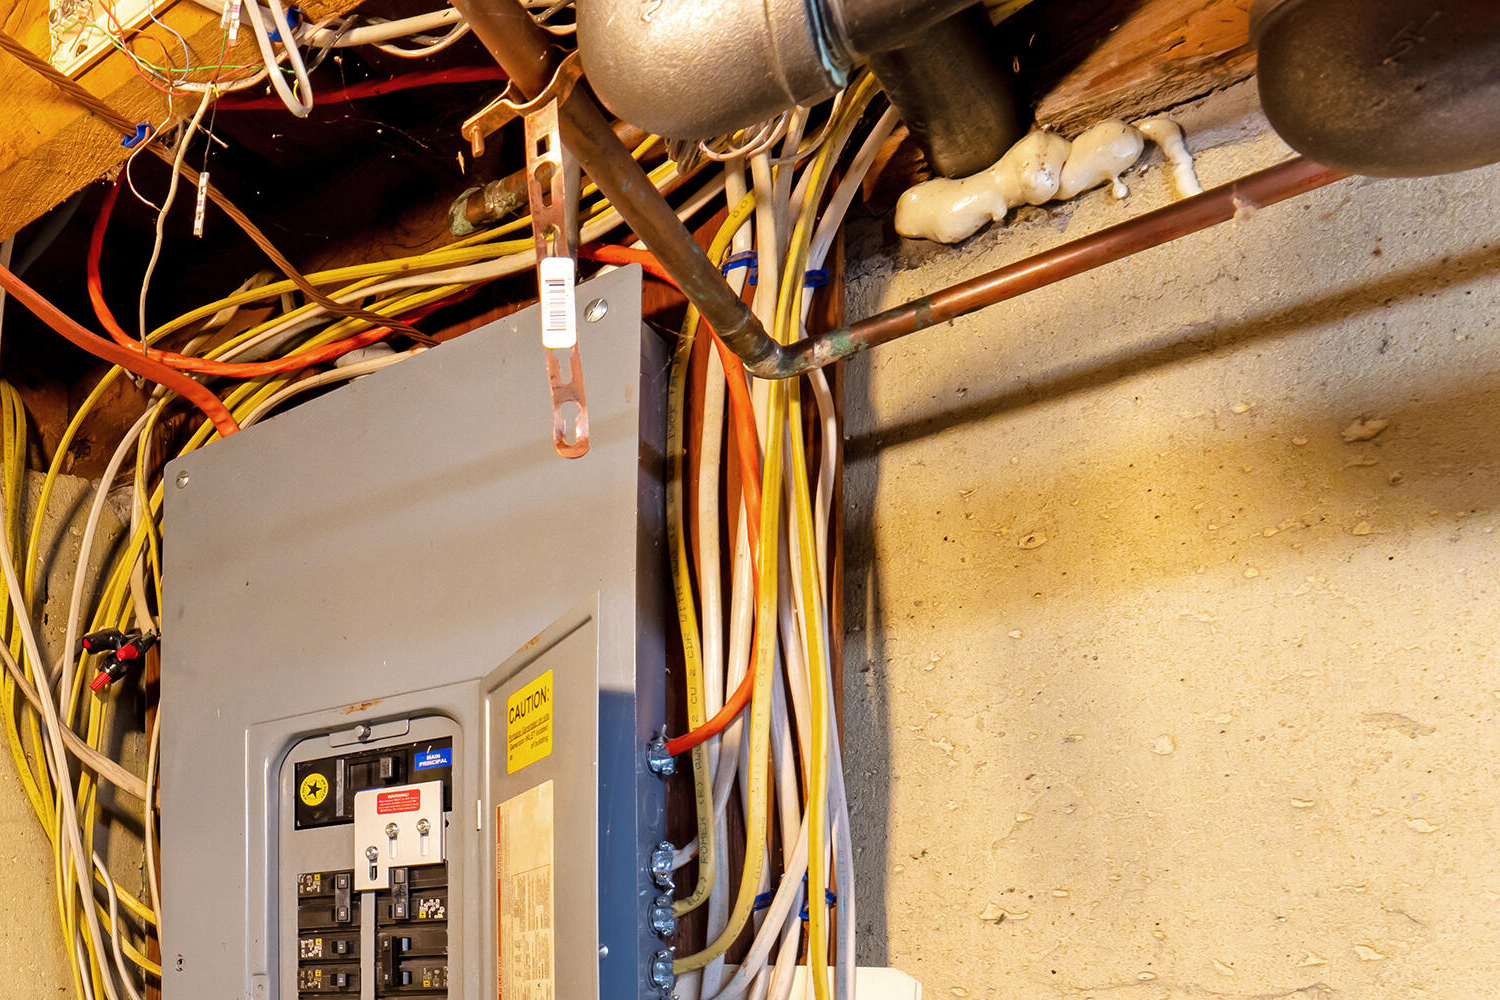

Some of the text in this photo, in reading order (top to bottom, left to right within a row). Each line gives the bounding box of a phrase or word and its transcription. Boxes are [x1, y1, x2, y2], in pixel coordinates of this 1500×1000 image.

[676, 586, 688, 623] WITH
[509, 685, 550, 724] CAUTION:
[690, 687, 698, 704] CU
[418, 758, 448, 768] PRINCIPAL
[426, 753, 441, 761] MAIN
[699, 816, 709, 864] ROMEX
